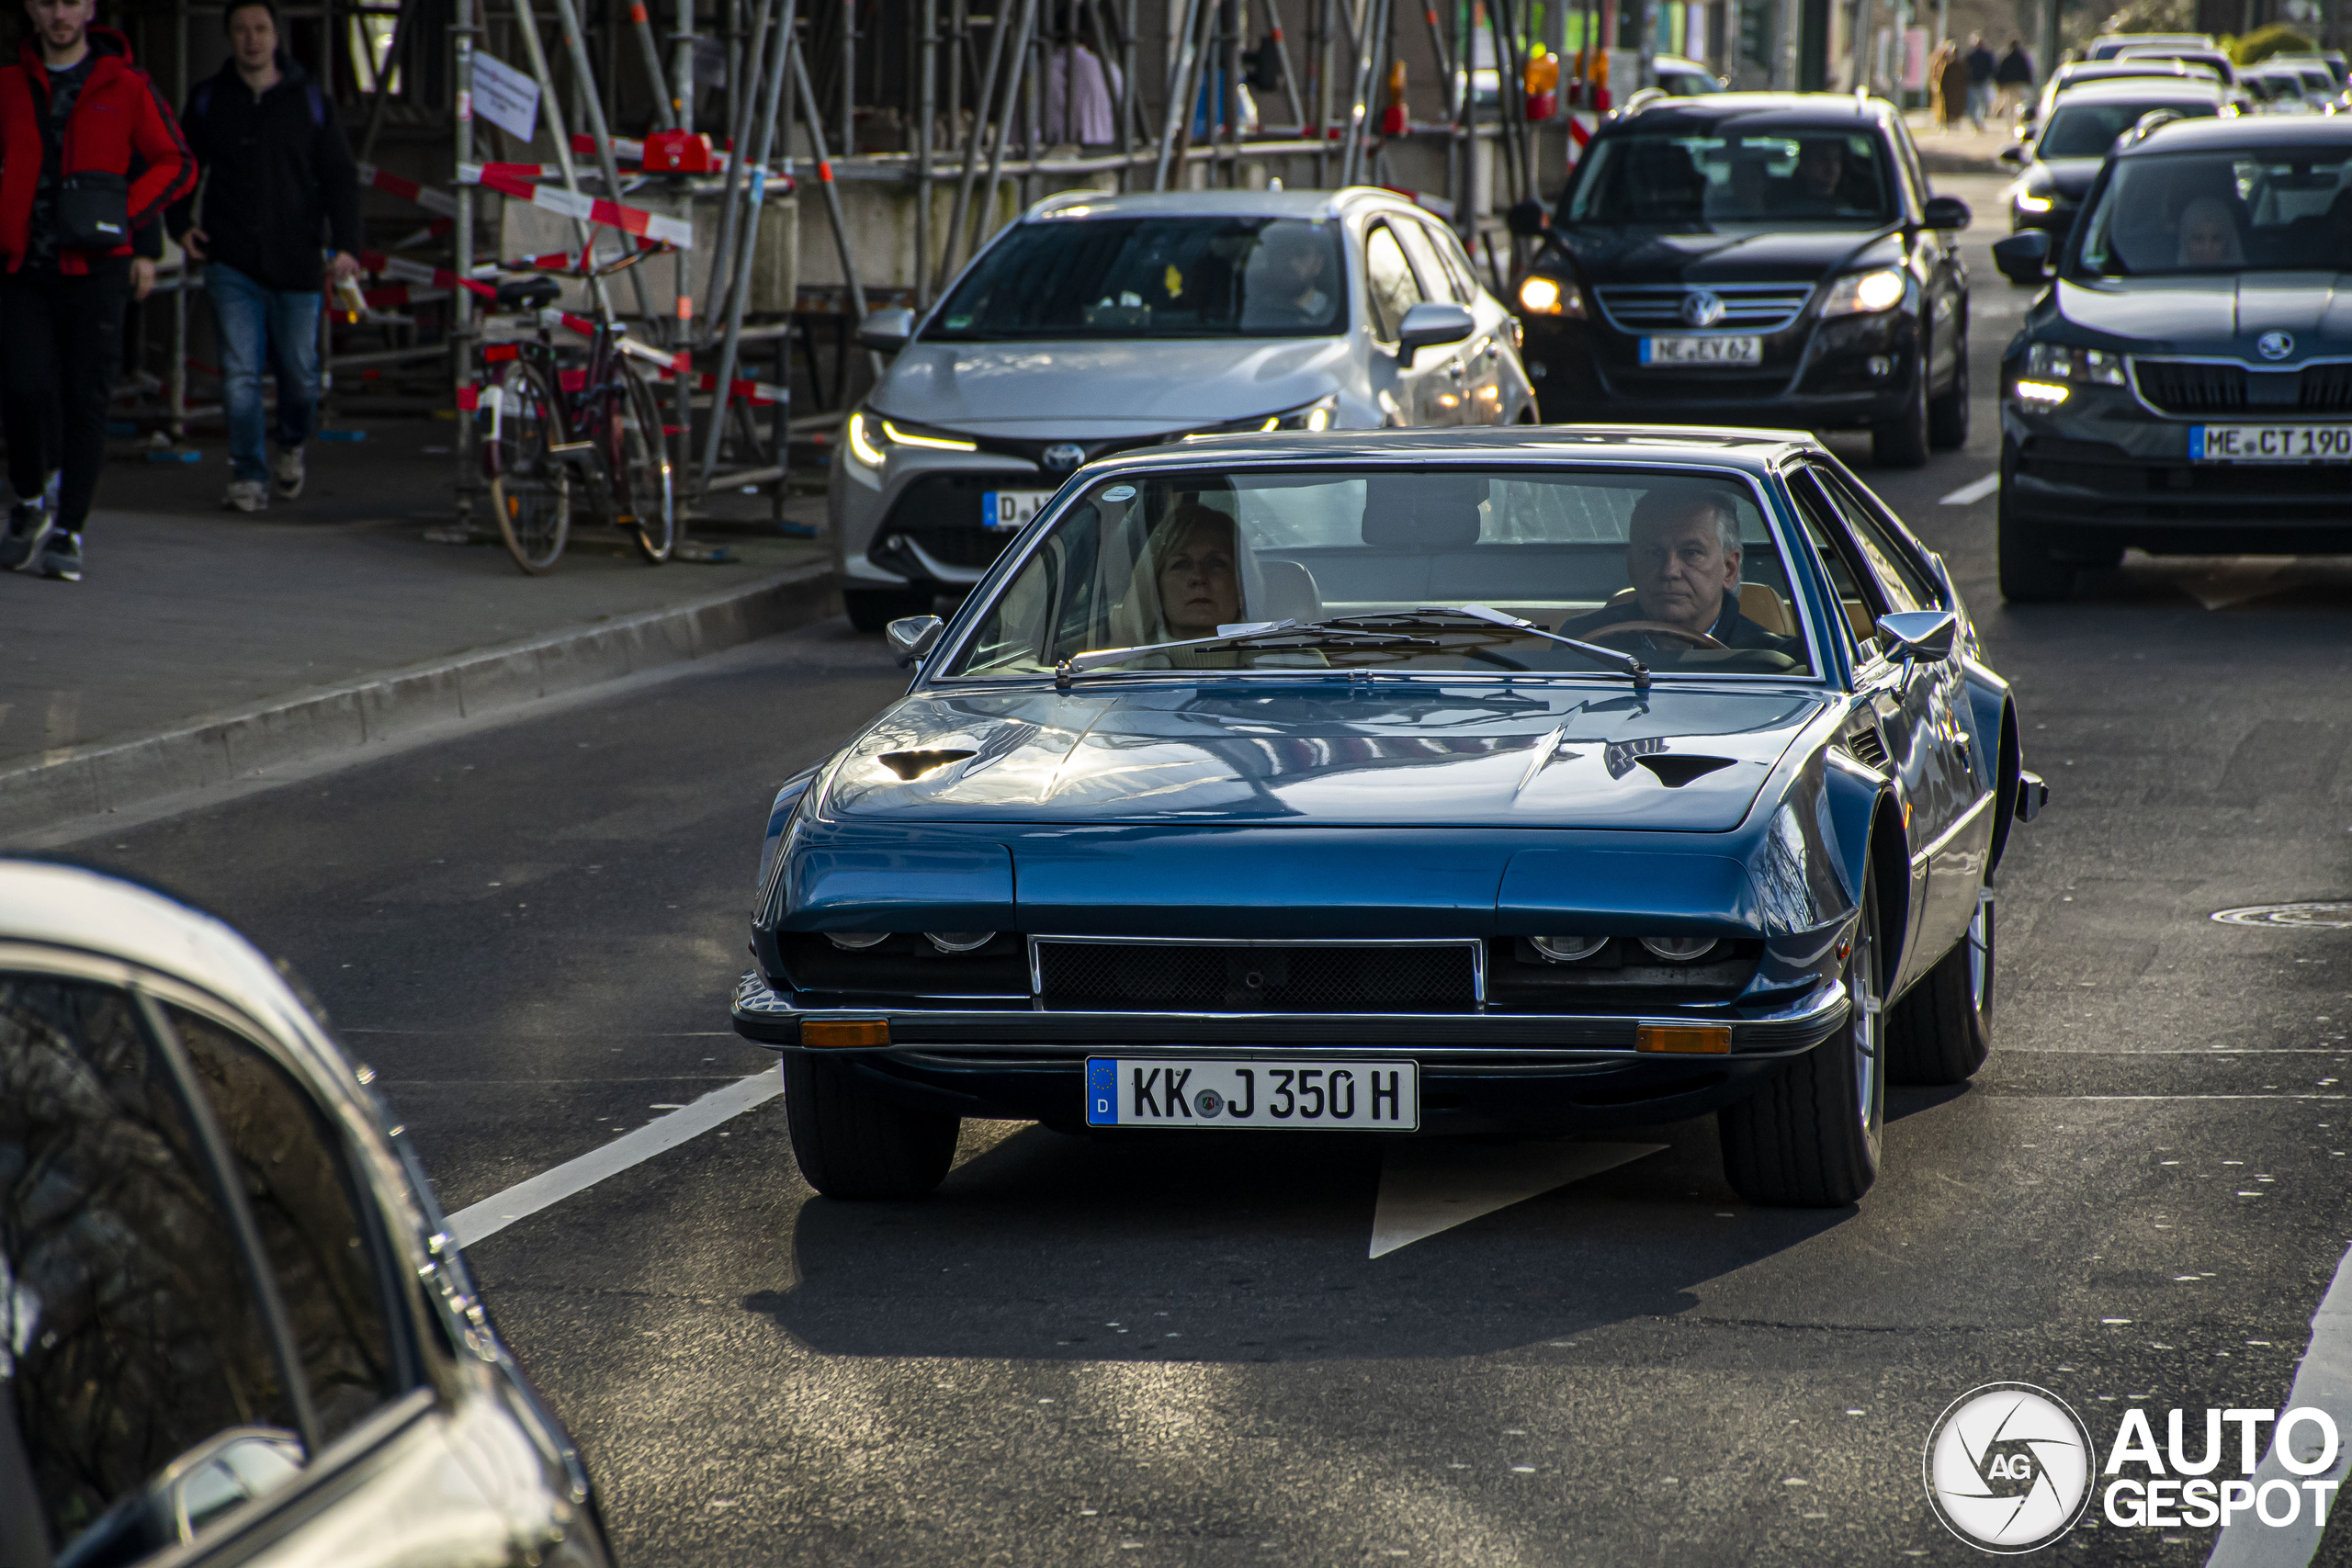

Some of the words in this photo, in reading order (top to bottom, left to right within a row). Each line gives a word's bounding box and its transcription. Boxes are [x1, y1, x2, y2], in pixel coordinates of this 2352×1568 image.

[2207, 430, 2240, 455] ME
[2260, 430, 2294, 455] CT
[2301, 430, 2351, 456] 190
[1001, 496, 1016, 521] D
[1097, 1099, 1109, 1113] D
[1134, 1067, 1193, 1118] KK
[1227, 1068, 1255, 1119] J
[1269, 1068, 1355, 1120] 350
[1371, 1070, 1399, 1121] H
